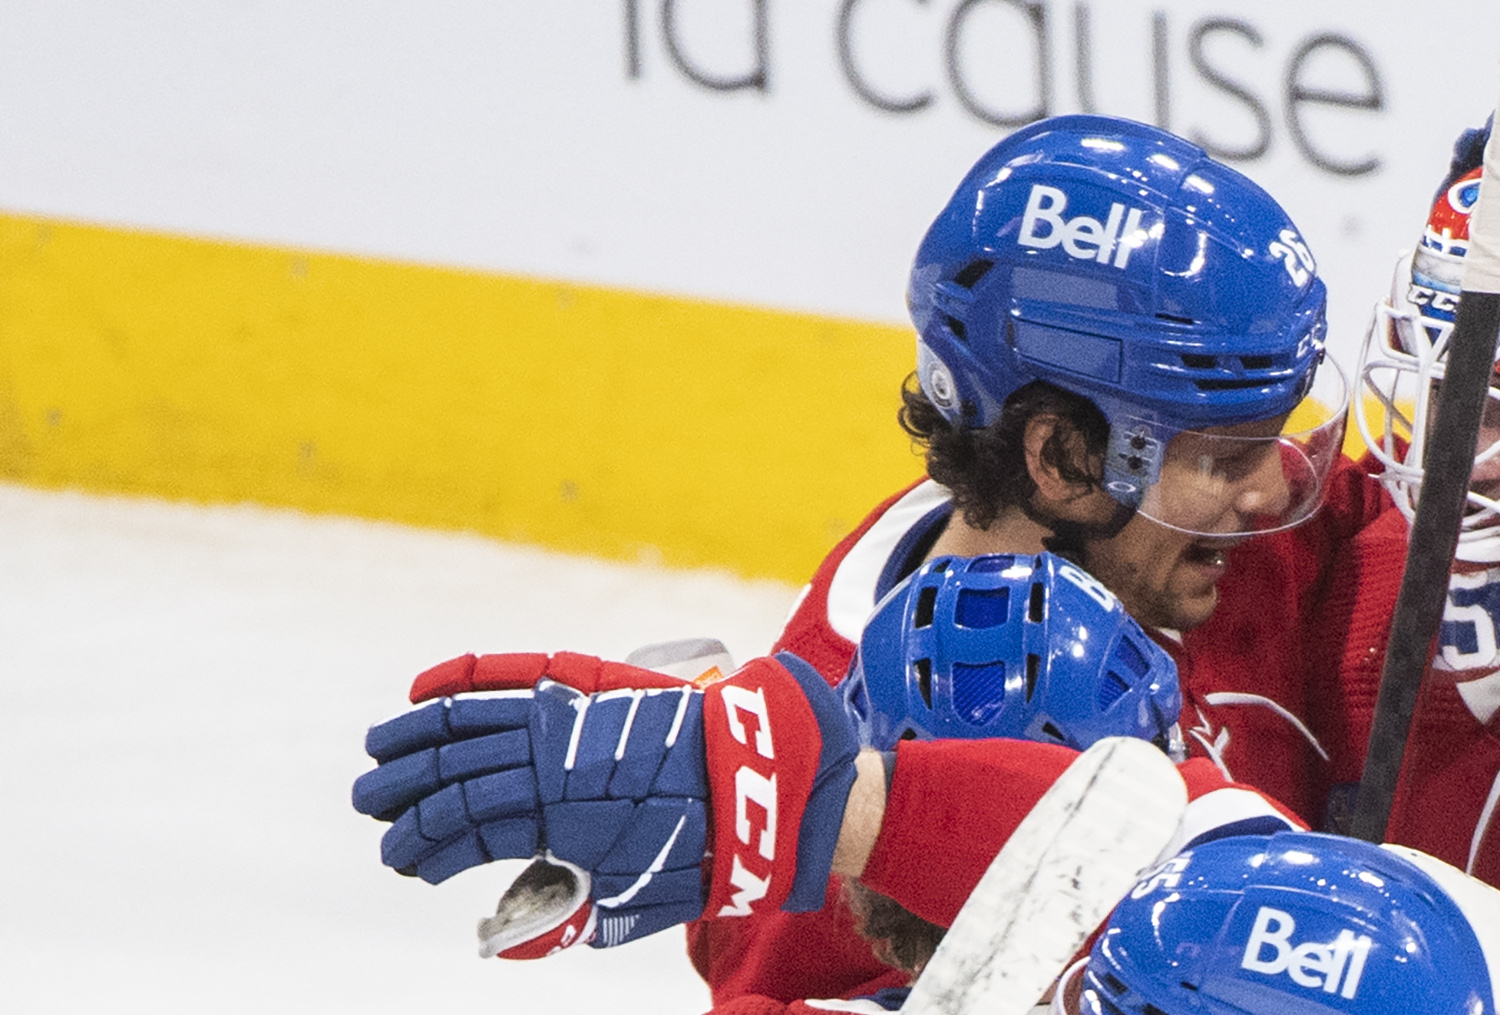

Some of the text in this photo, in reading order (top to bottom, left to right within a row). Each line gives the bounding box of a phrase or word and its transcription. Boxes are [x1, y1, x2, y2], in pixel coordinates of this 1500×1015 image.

[831, 0, 1386, 177] cause
[1018, 183, 1146, 270] Bell
[1268, 228, 1316, 288] 26
[1406, 283, 1463, 313] CC
[1441, 570, 1499, 670] 5
[715, 684, 779, 918] CCM
[1240, 906, 1374, 999] Bell
